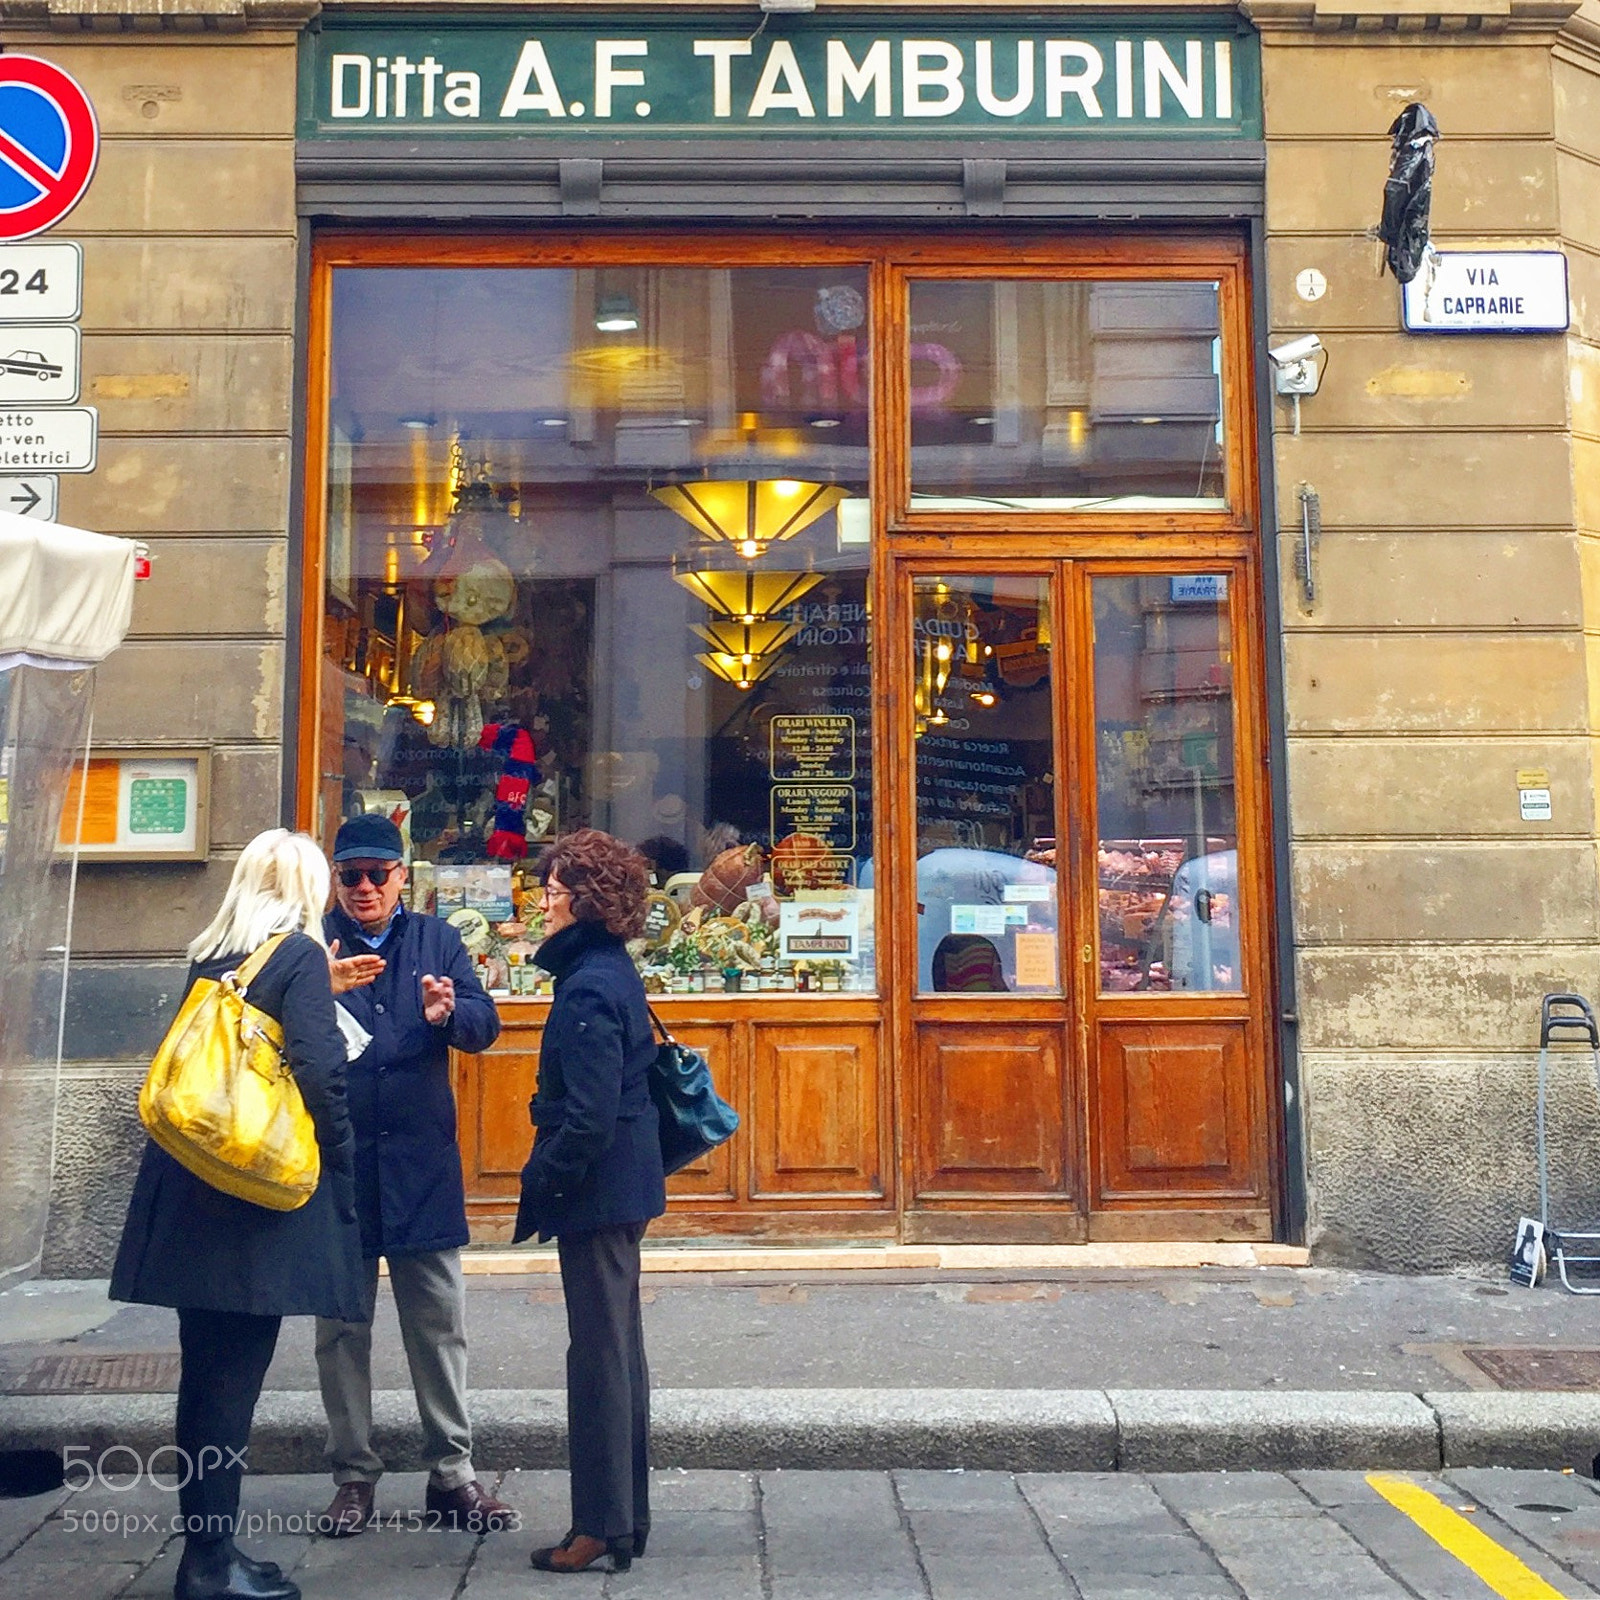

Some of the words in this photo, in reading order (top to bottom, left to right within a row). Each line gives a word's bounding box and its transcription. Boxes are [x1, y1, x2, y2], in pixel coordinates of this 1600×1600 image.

[331, 54, 481, 119] Ditta
[499, 40, 650, 118] A.F.
[694, 40, 1232, 119] TAMBURINI
[1466, 268, 1499, 286] VIA
[1307, 287, 1316, 298] A
[1443, 297, 1524, 315] CAPRARIE
[0, 435, 45, 446] -ven
[0, 451, 70, 465] lettrici
[806, 718, 829, 727] WINE
[830, 718, 848, 727] BAR
[777, 788, 806, 797] ORARI
[808, 788, 849, 797] NEGOZIO
